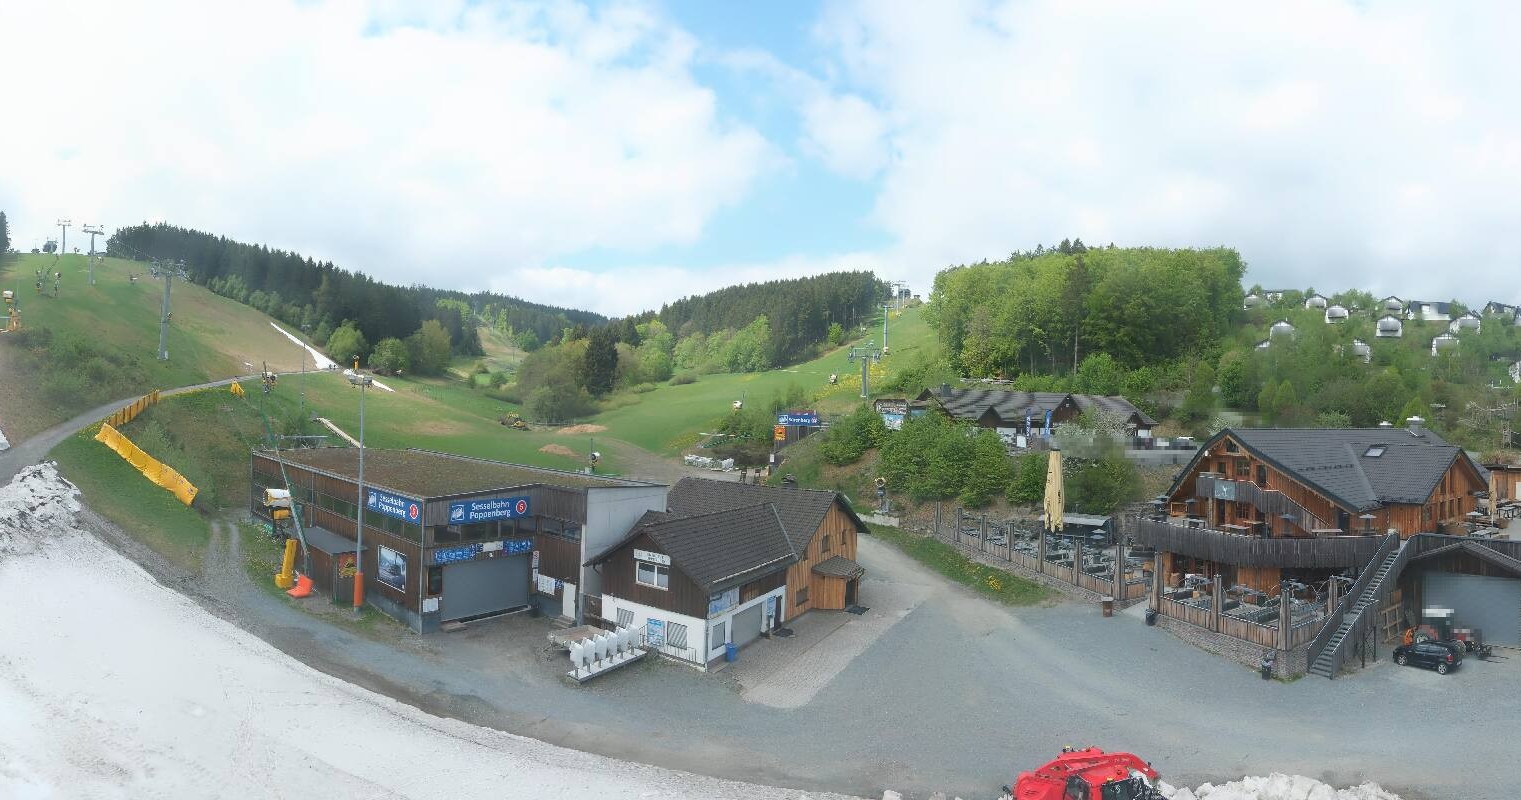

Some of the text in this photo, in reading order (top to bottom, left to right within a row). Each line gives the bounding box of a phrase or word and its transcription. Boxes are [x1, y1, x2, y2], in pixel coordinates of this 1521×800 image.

[380, 493, 405, 507] Sesselbahn
[472, 501, 510, 511] Sesselbahn
[378, 502, 406, 518] Poppenberg
[470, 509, 511, 520] Poppenberg
